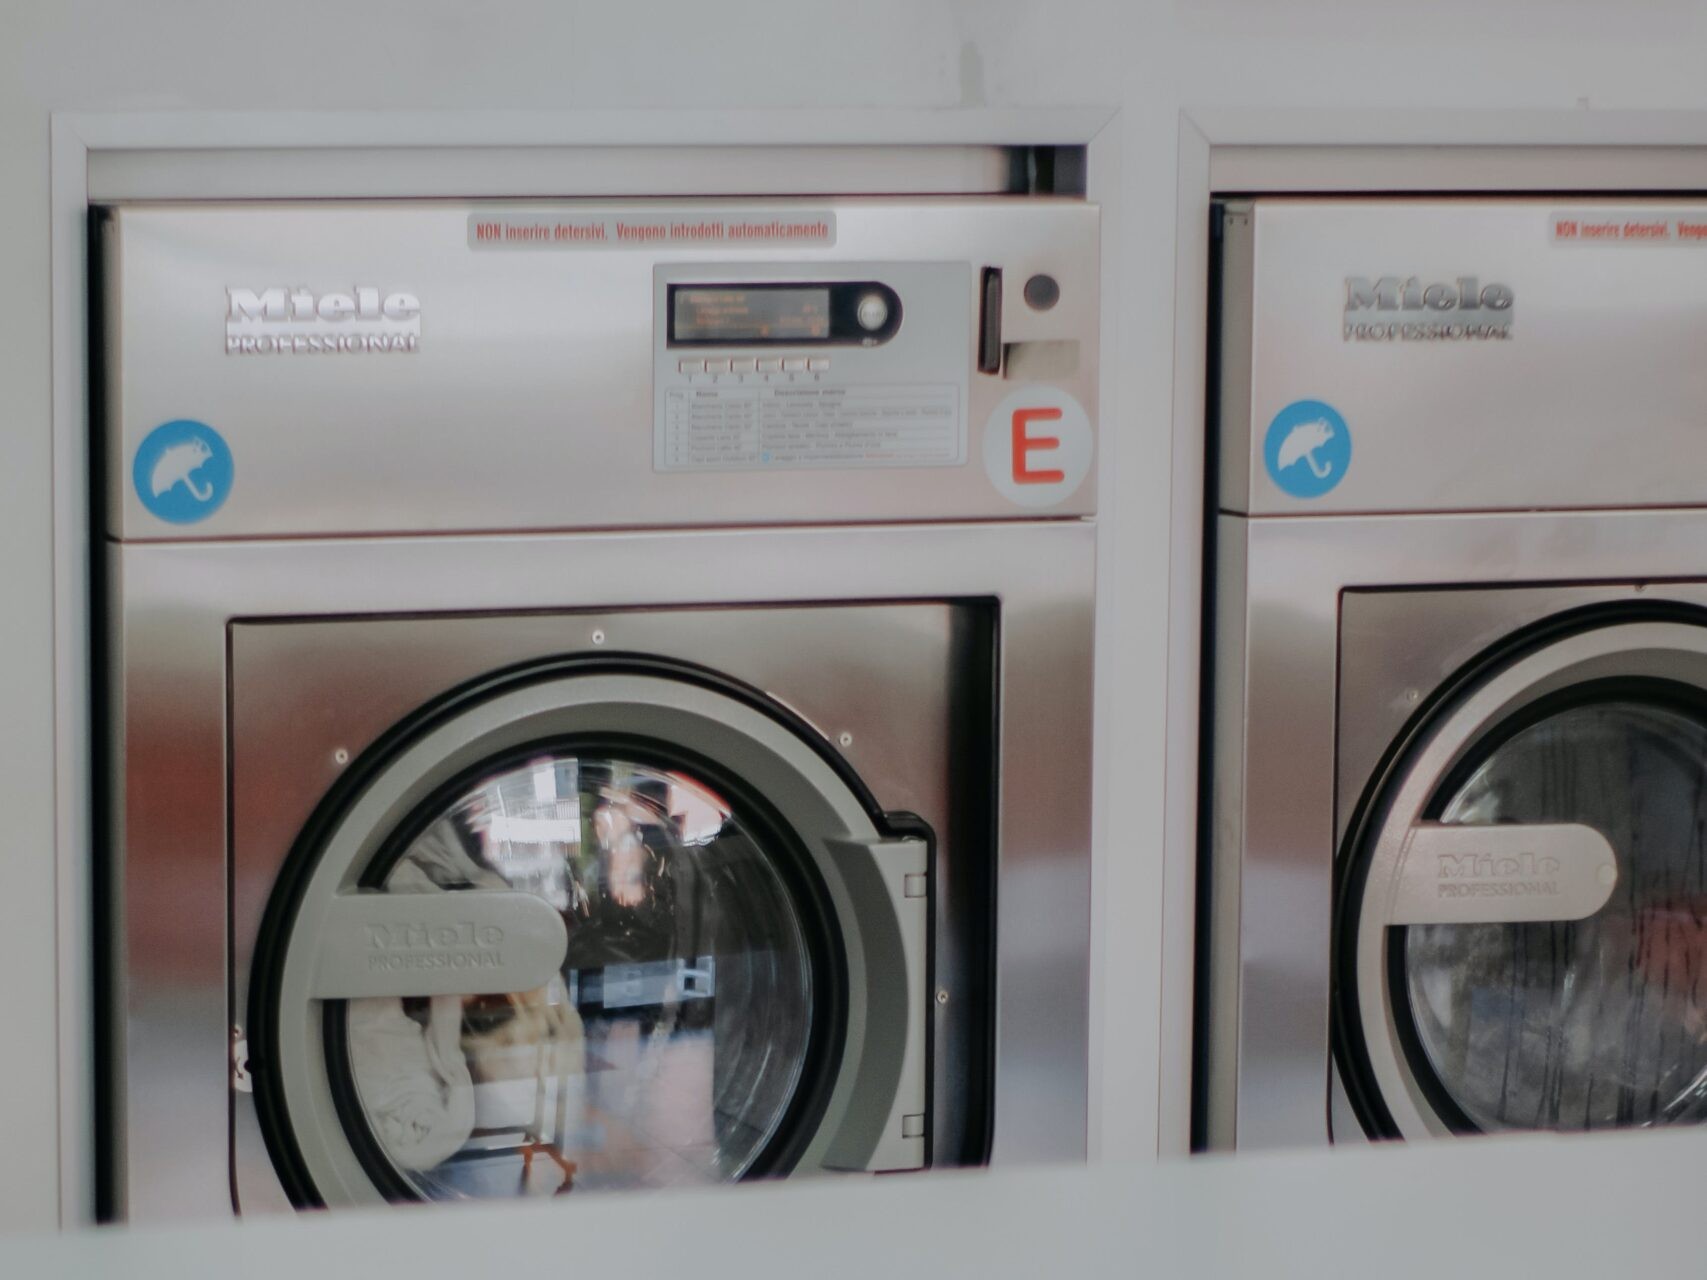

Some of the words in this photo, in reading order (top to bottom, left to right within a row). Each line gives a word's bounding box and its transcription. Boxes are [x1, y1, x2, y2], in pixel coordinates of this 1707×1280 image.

[476, 223, 501, 240] NON
[505, 222, 550, 240] inserire
[616, 221, 666, 242] Vengono
[670, 220, 724, 240] introdotti
[728, 220, 828, 240] automaticamente
[1556, 221, 1578, 237] NON
[1581, 221, 1620, 237] inserire
[225, 286, 420, 321] Miele
[1344, 276, 1514, 312] Miele
[1344, 322, 1513, 342] PROFESSIONAL
[225, 335, 418, 355] PROFESSIONAL
[1012, 408, 1064, 485] E
[1437, 852, 1561, 879] Miele
[1437, 882, 1561, 898] PROFESSIONAL
[366, 921, 505, 949] Miele
[368, 951, 505, 972] PROFESSIONAL
